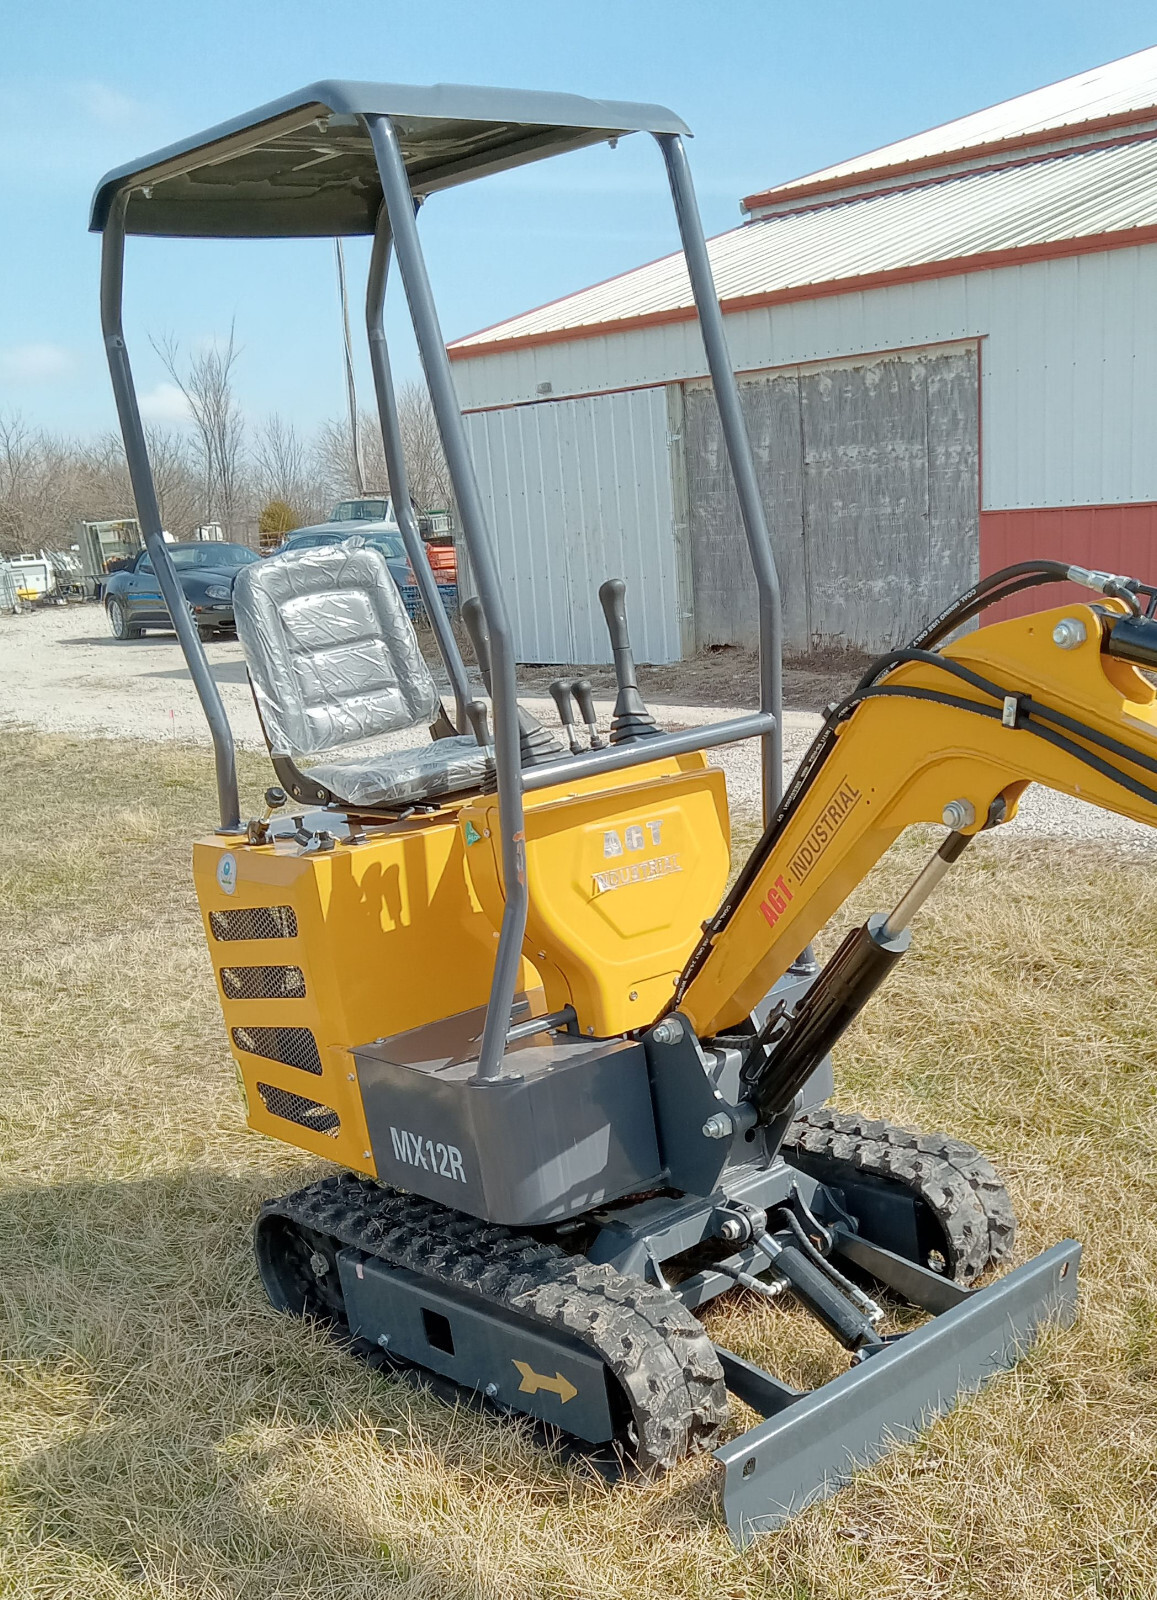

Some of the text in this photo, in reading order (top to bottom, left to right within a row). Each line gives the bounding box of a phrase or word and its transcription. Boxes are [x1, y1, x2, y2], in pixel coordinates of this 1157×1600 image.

[960, 588, 977, 602] COAL
[939, 601, 960, 621] MINING
[927, 619, 941, 633] USE
[912, 630, 929, 647] ONLY
[603, 820, 664, 859] AGT
[759, 874, 794, 929] AGT
[789, 782, 860, 882] INDUSTRIAL
[389, 1126, 468, 1184] MX12R
